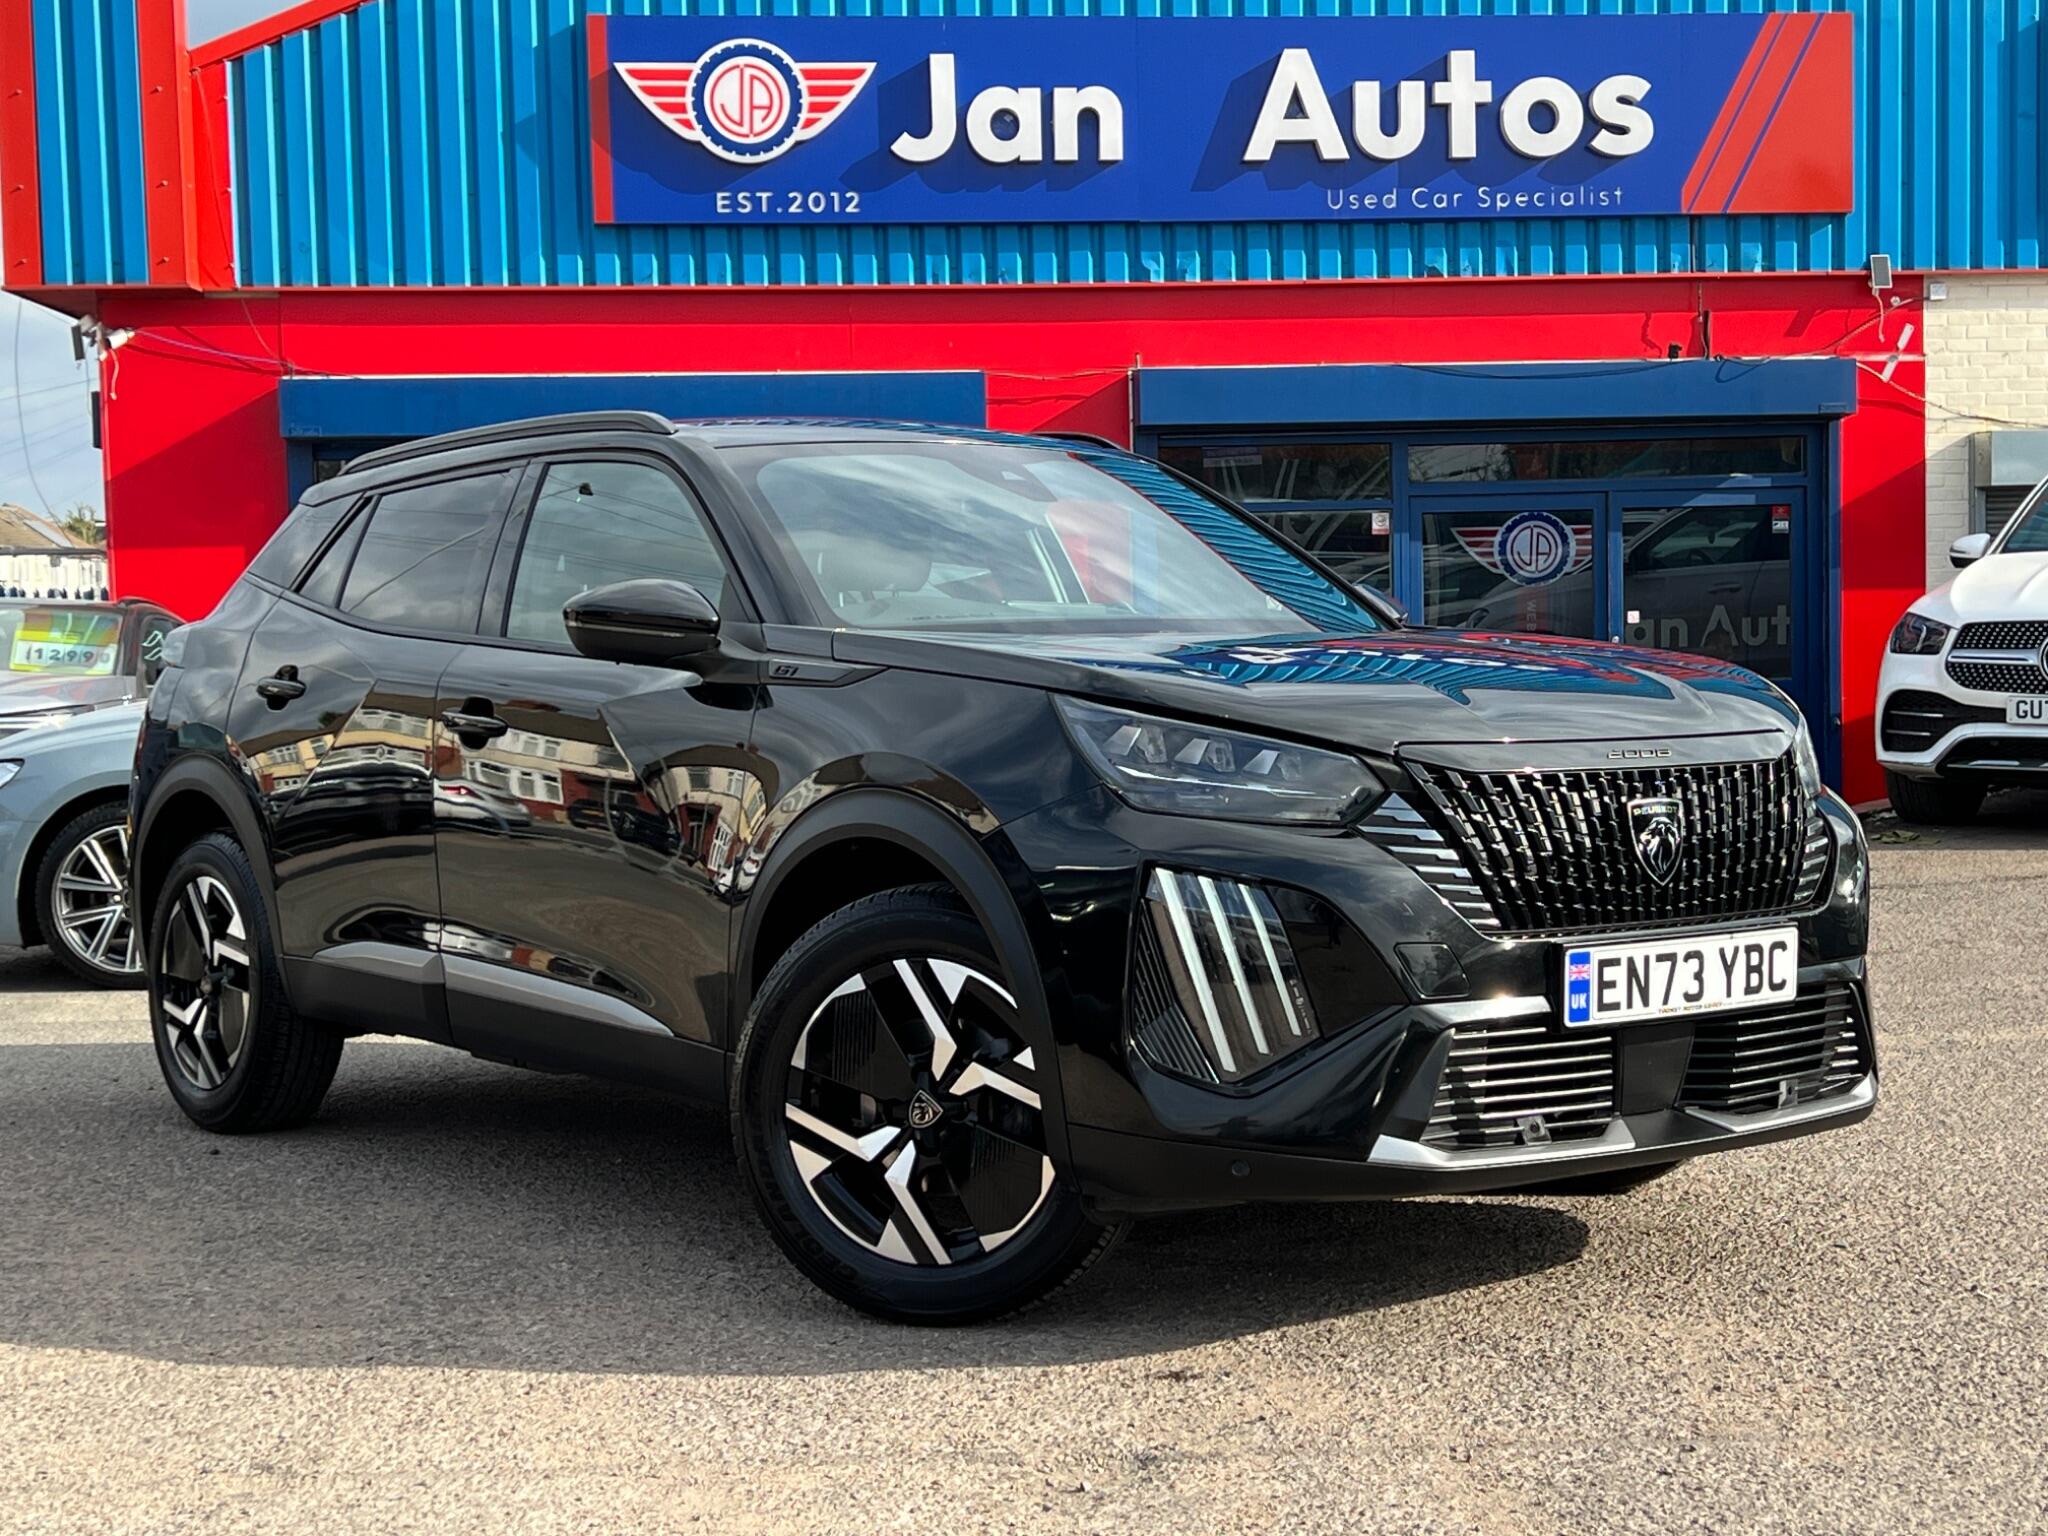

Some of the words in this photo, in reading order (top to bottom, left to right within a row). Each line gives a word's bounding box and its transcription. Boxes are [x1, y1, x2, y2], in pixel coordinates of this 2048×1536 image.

[890, 52, 1124, 163] Jan
[1242, 47, 1656, 163] Autos
[715, 191, 862, 214] EST.2012
[1327, 188, 1397, 209] Used
[1411, 187, 1463, 209] Car
[1477, 185, 1624, 211] Specialist
[2015, 700, 2048, 719] GU
[1597, 949, 1705, 1013] EN73
[1719, 940, 1788, 998] YBC
[1571, 993, 1587, 1009] UK
